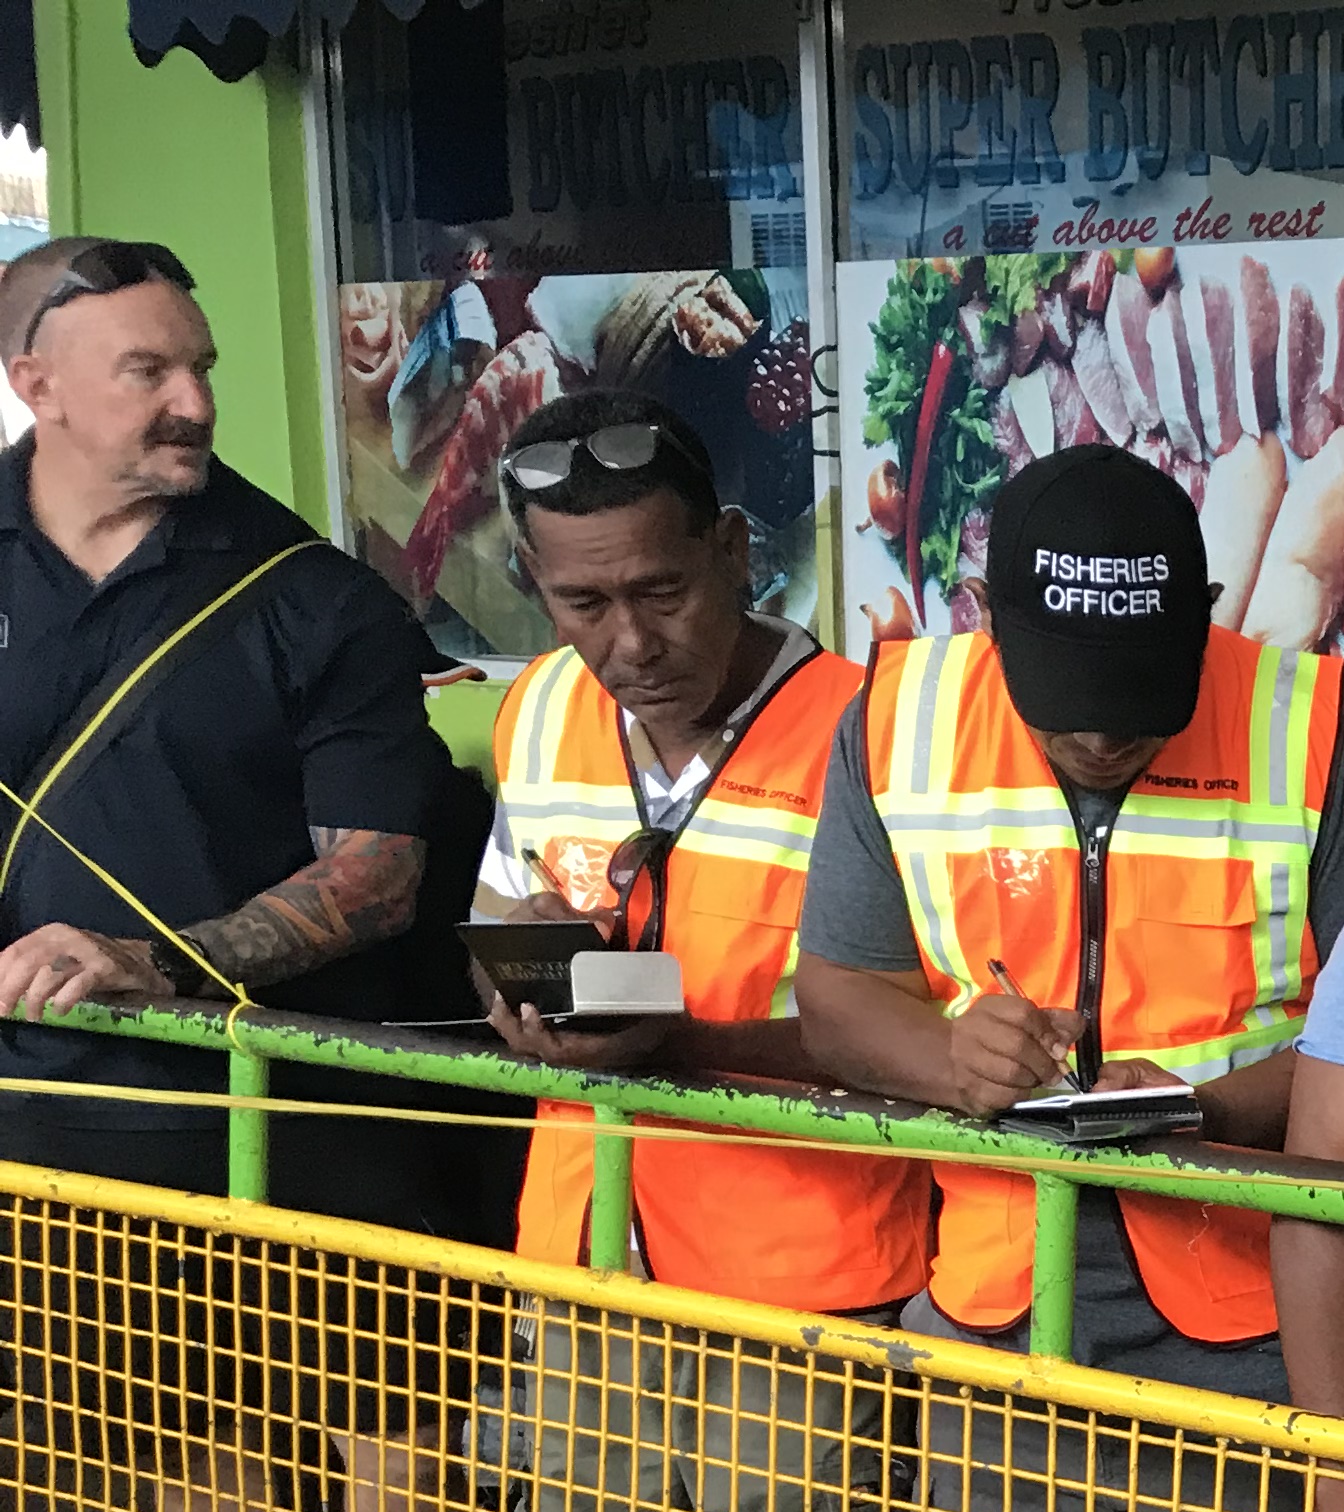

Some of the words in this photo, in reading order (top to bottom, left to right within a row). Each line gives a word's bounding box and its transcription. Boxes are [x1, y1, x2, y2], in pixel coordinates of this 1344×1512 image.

[855, 32, 1065, 198] SUPER
[519, 55, 803, 213] BUTCHER
[942, 224, 966, 251] a
[983, 213, 1040, 249] cut
[1052, 201, 1158, 246] above
[1172, 195, 1232, 242] the
[1249, 200, 1326, 240] rest
[1034, 548, 1170, 584] FISHERIES
[1044, 584, 1165, 616] OFFICER
[720, 779, 767, 798] FISHERIES
[769, 790, 808, 807] OFFICER
[1145, 774, 1198, 790] FISHERIES
[1203, 779, 1239, 791] OFFICER
